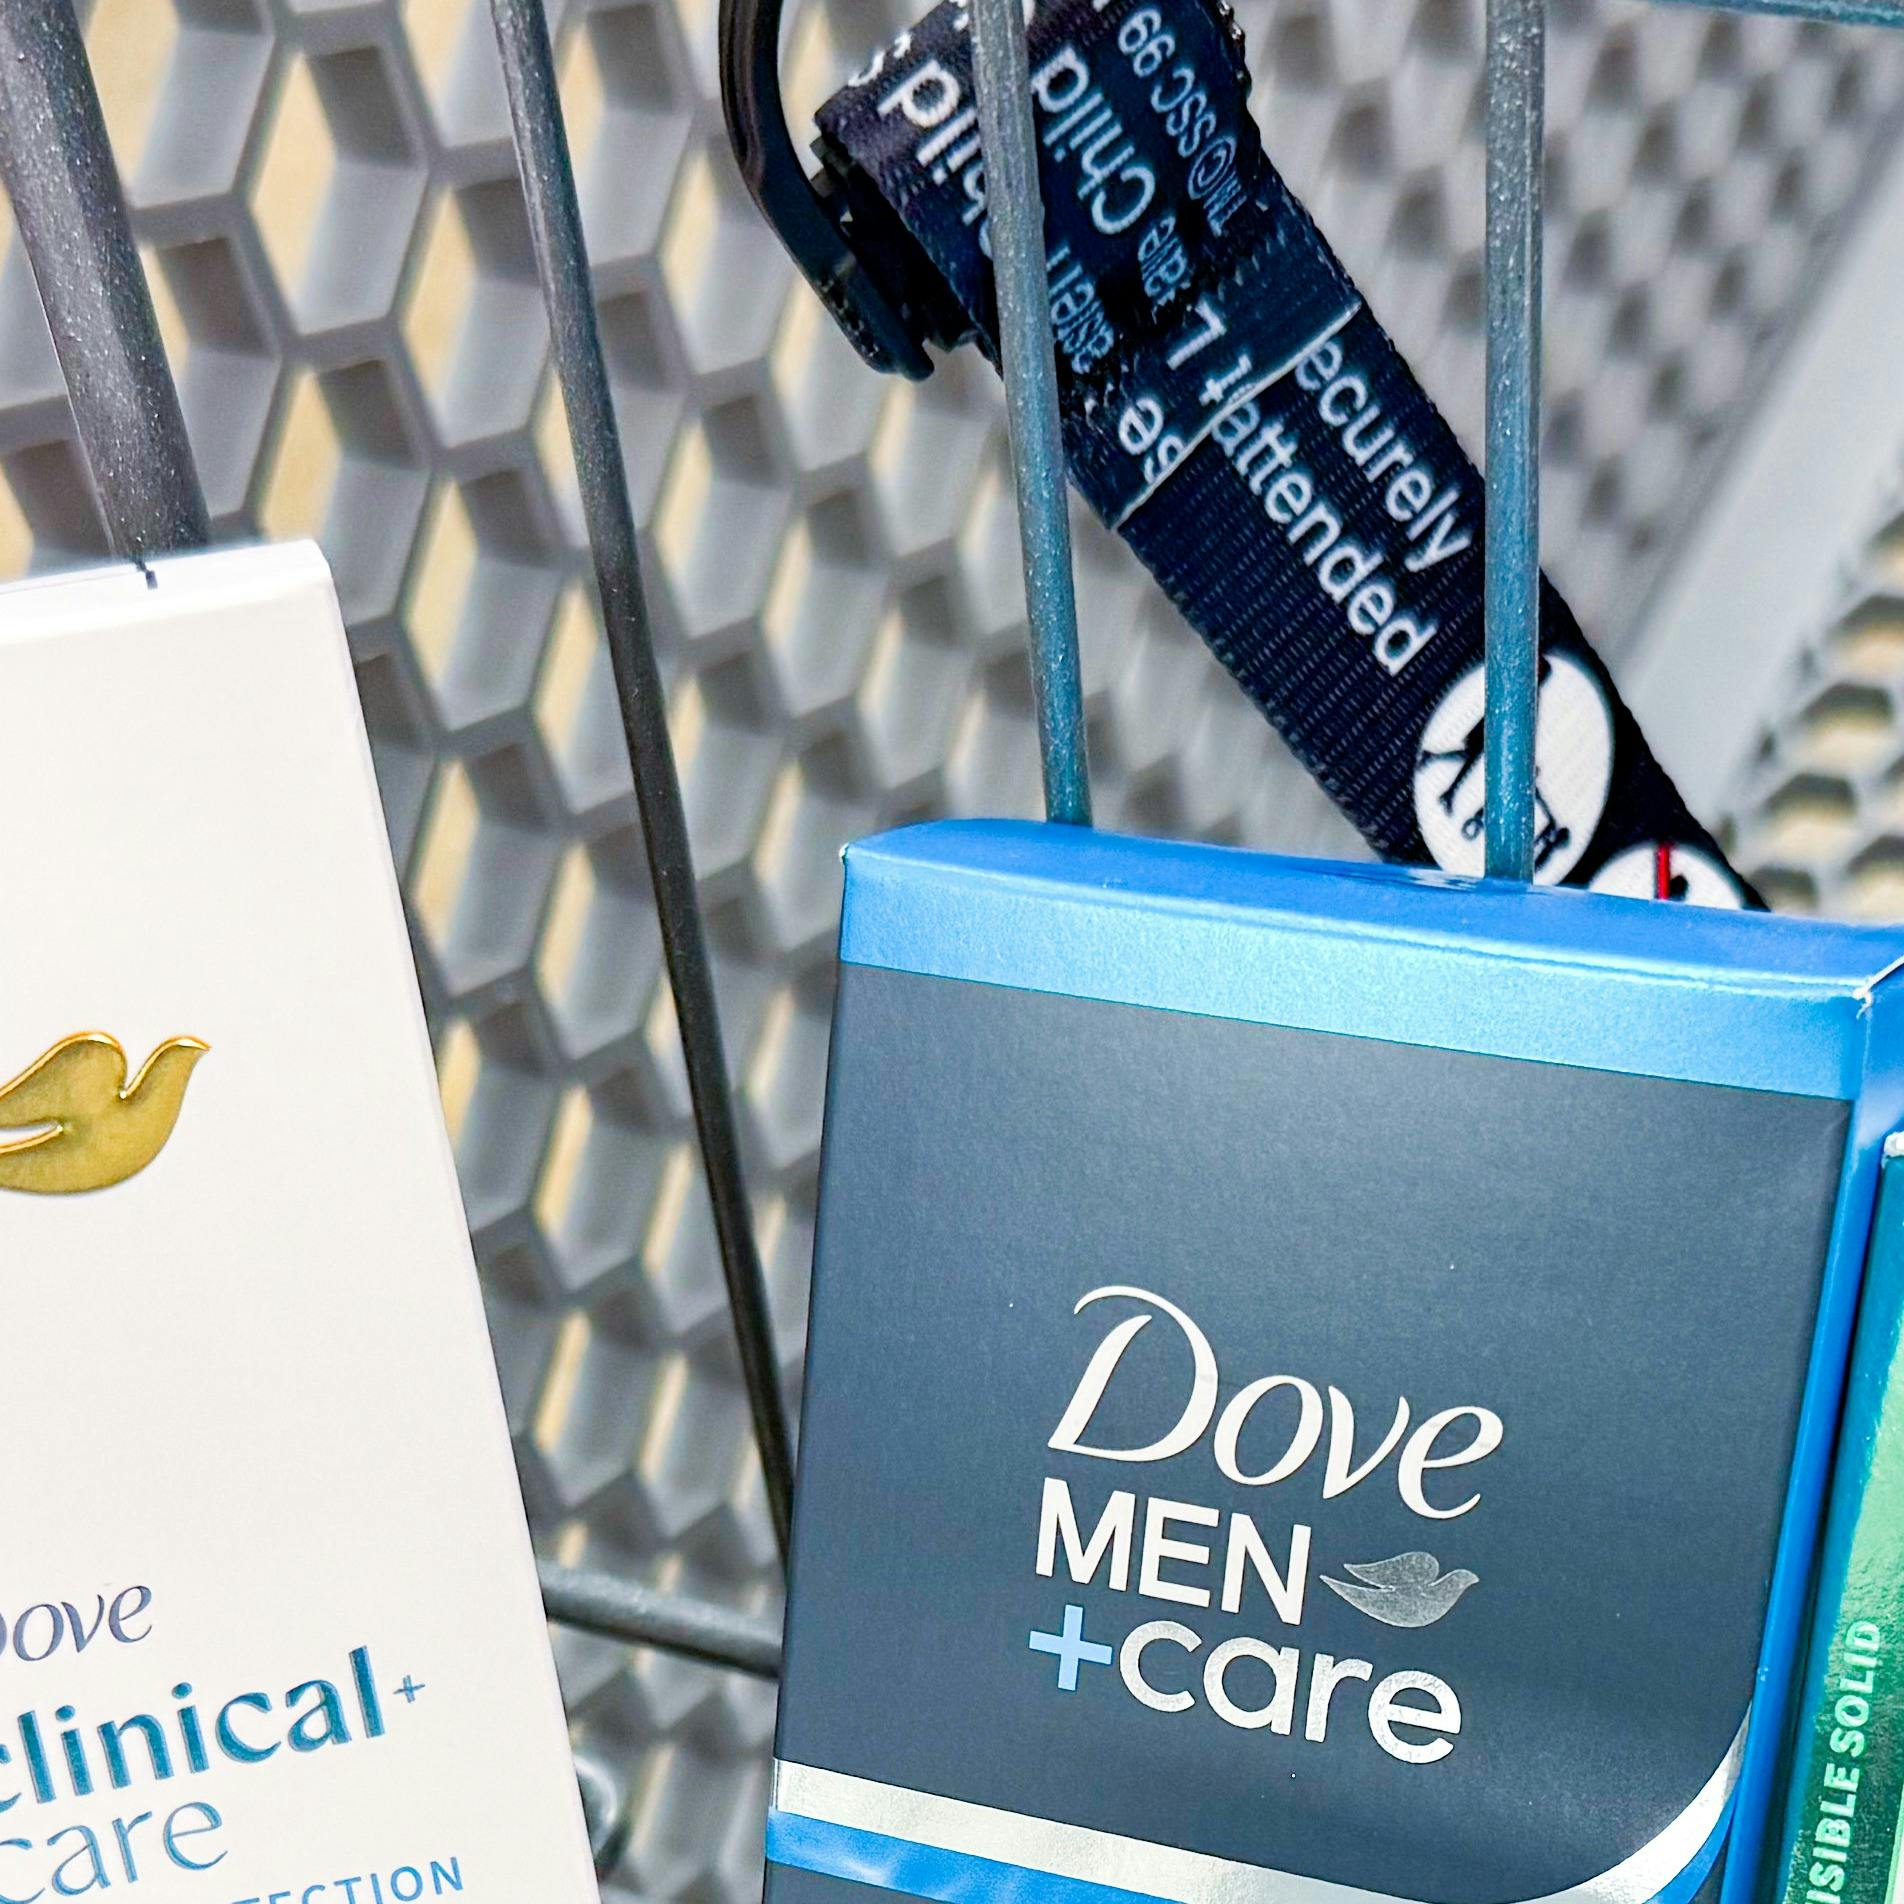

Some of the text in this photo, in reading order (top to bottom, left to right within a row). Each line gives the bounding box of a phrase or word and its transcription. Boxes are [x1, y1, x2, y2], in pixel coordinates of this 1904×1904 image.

[877, 58, 996, 262] hild
[1031, 46, 1156, 236] Child
[1214, 398, 1437, 678] attended
[1296, 333, 1474, 575] ecurely
[1048, 1285, 1504, 1520] Dove
[1035, 1477, 1311, 1625] MEN
[1833, 1618, 1883, 1758] SOLID
